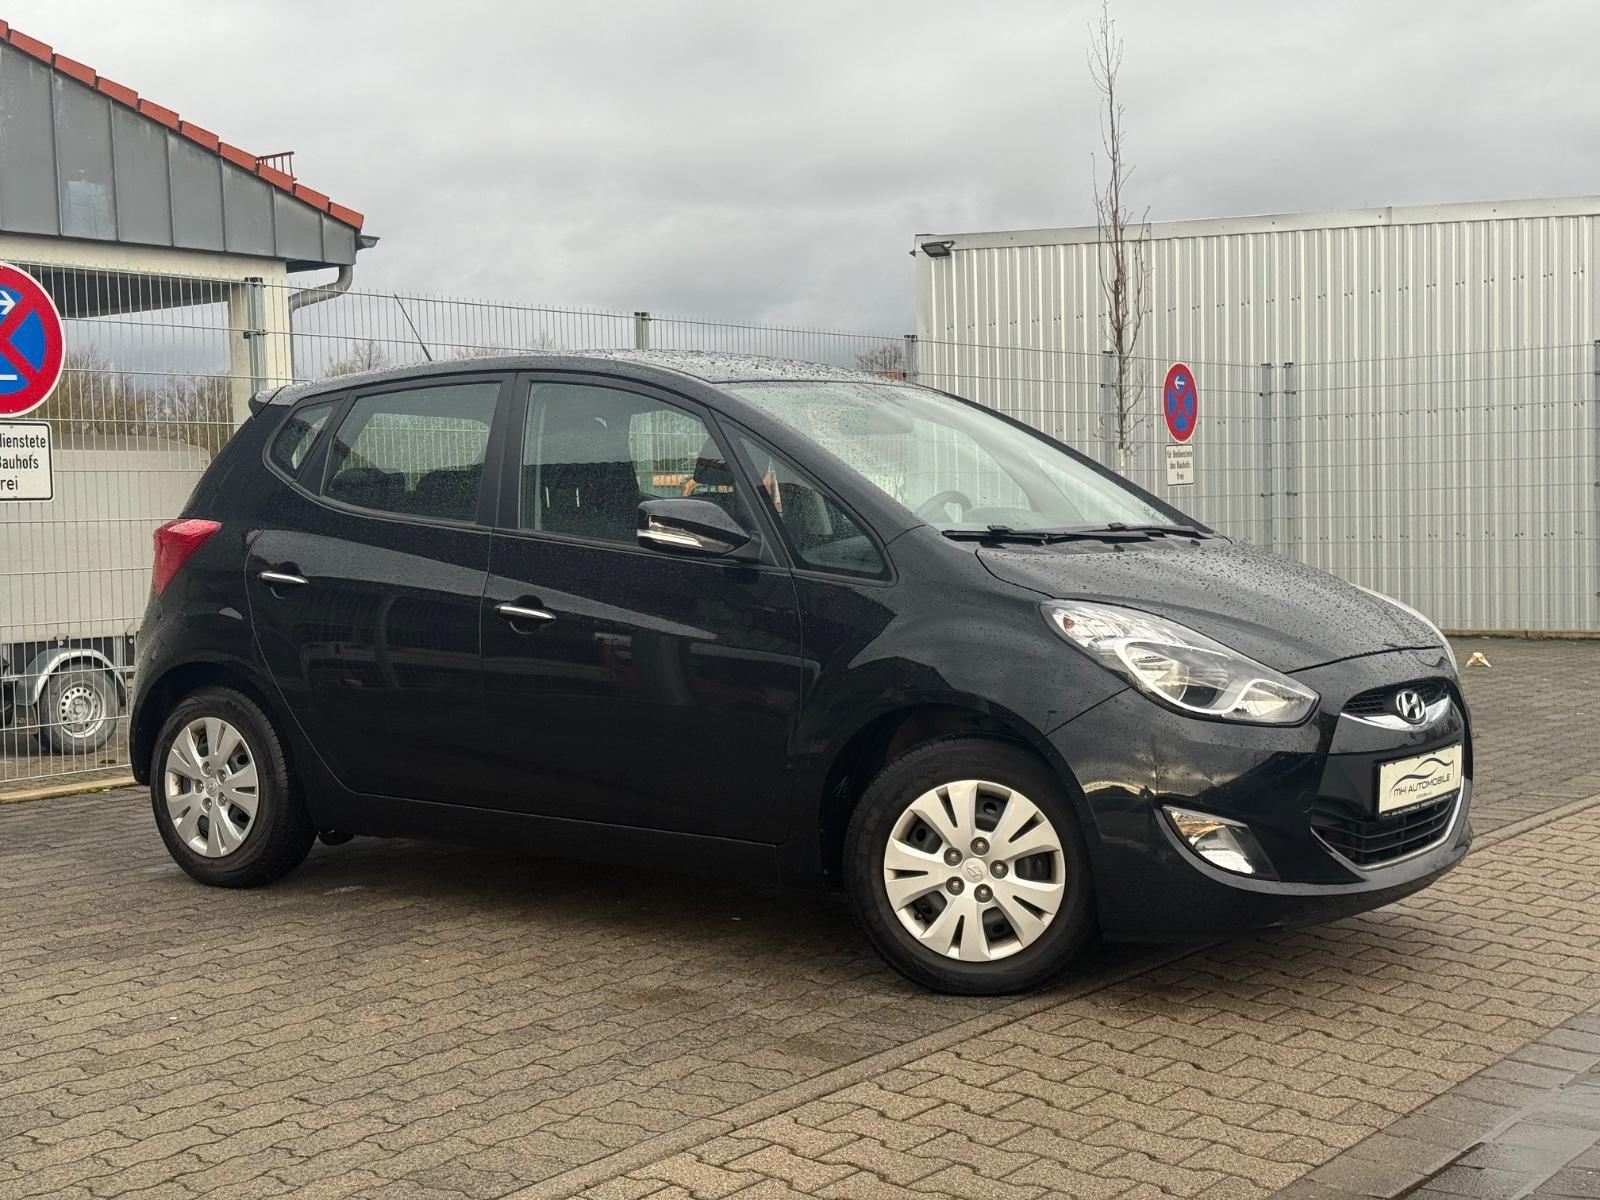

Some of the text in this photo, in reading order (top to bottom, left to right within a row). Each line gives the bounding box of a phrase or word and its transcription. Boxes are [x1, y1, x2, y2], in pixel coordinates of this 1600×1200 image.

[0, 454, 39, 469] auhofs
[0, 475, 18, 490] rei
[1393, 785, 1407, 798] MH
[1408, 774, 1451, 792] AUTOMOBILE
